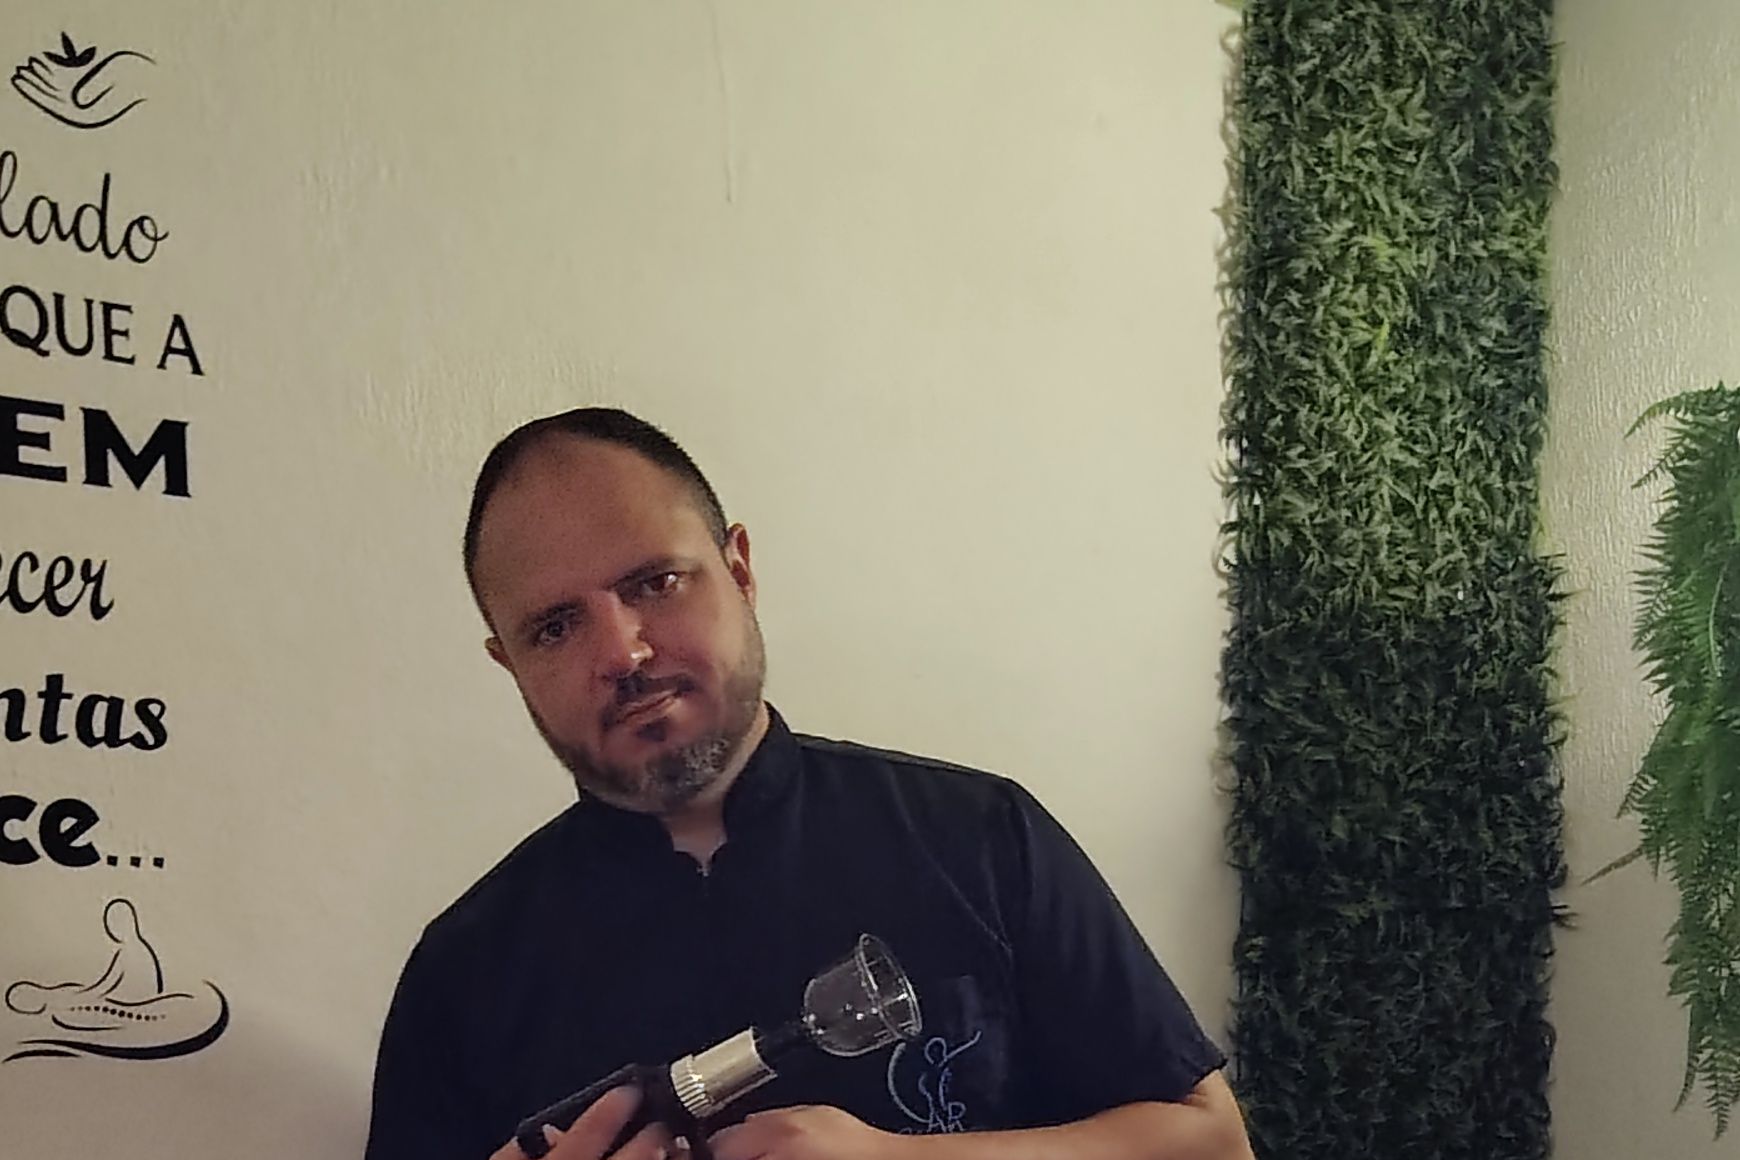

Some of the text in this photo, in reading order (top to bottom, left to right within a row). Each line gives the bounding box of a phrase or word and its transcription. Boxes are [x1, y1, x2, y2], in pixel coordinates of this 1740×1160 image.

[0, 150, 169, 263] lado
[0, 284, 206, 376] QUE A
[0, 395, 191, 498] EM
[0, 550, 115, 621] cer
